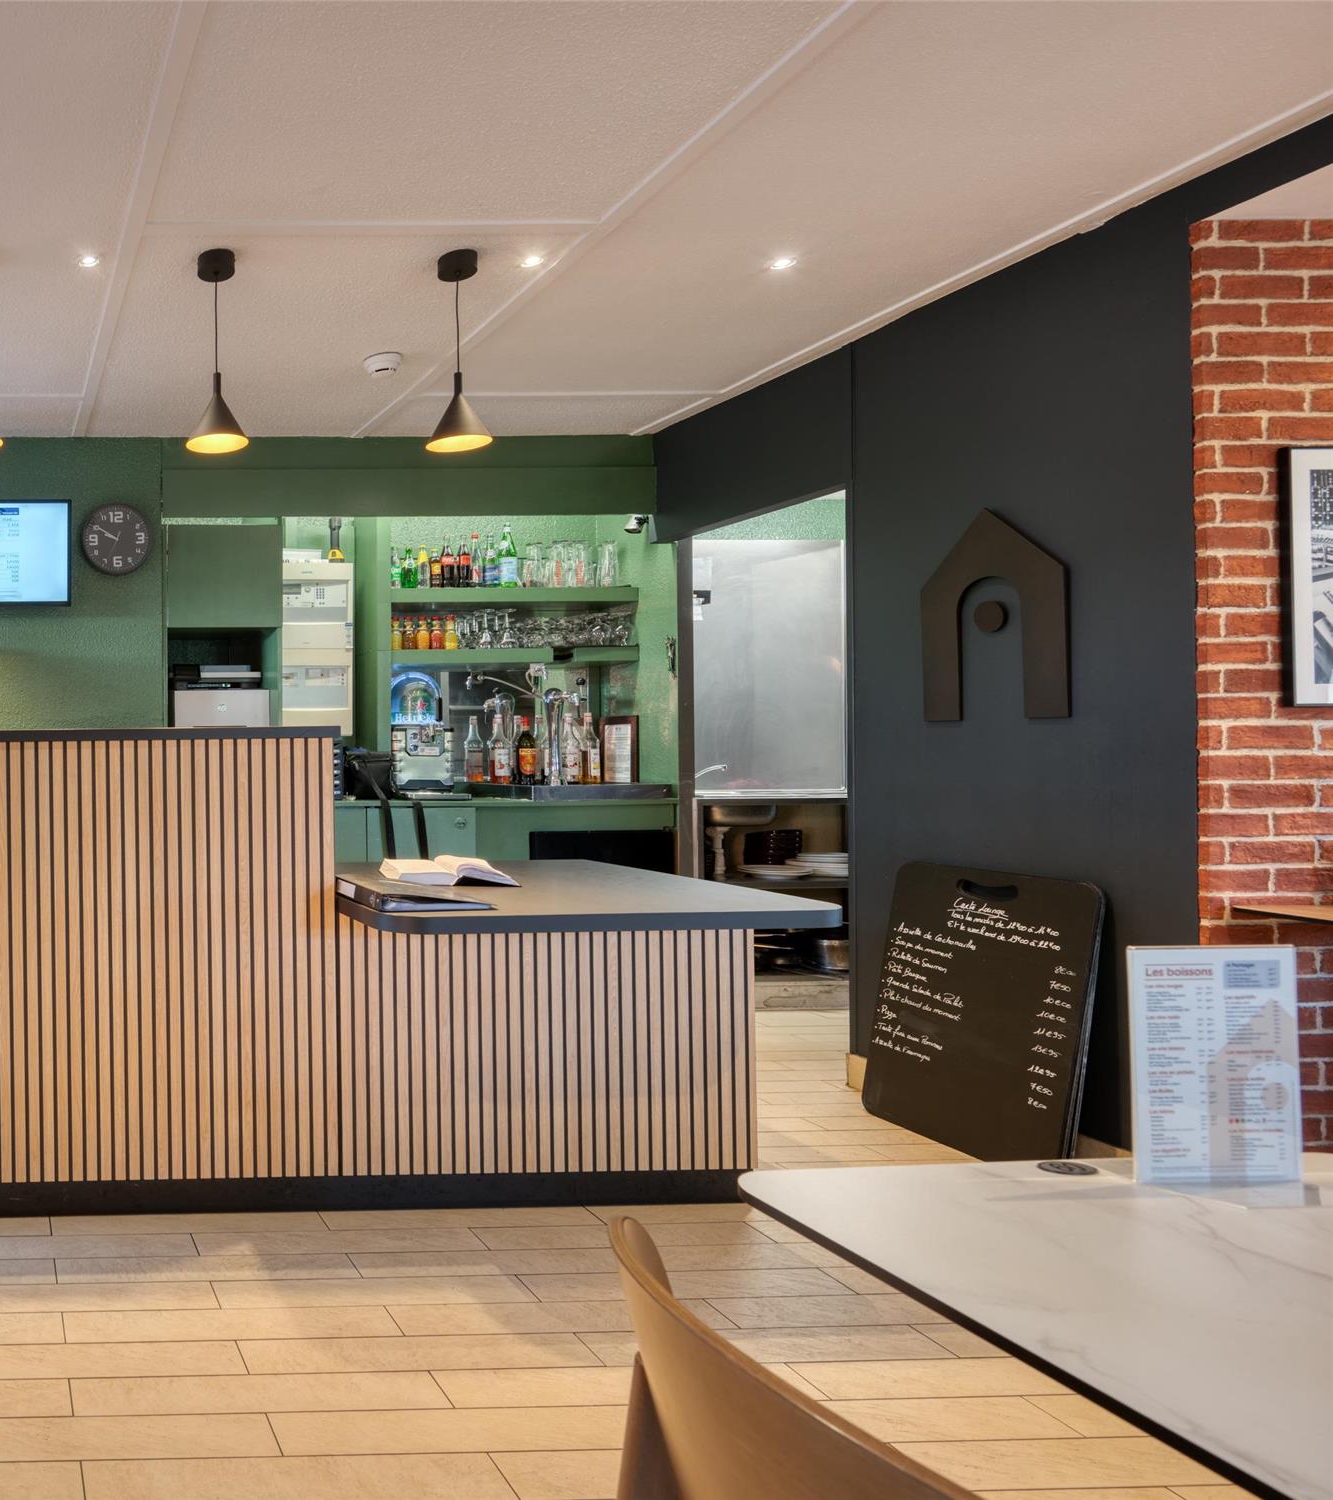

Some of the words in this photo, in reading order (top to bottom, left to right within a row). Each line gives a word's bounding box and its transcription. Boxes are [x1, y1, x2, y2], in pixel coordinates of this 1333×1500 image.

[109, 511, 123, 523] 12
[89, 534, 98, 546] 9
[135, 532, 145, 544] 3
[113, 556, 122, 567] 6
[395, 713, 436, 722] Heineke
[954, 897, 976, 910] Carte
[978, 903, 1008, 918] Lounge
[951, 910, 964, 919] Tous
[995, 921, 1005, 929] de
[923, 931, 932, 940] de
[947, 920, 959, 928] Et
[997, 933, 1006, 941] de
[895, 936, 913, 948] Soupe
[914, 944, 924, 952] du
[924, 948, 953, 959] moment
[912, 957, 920, 965] de
[1145, 967, 1164, 977] Les
[1166, 967, 1213, 977] boissons
[1049, 980, 1072, 992] 7€50
[933, 993, 942, 1001] de
[883, 988, 901, 1001] Plat
[901, 996, 922, 1009] chaud
[922, 1004, 932, 1012] du
[933, 1008, 962, 1021] moment
[881, 1004, 897, 1020] Pizza
[1033, 1028, 1067, 1040] 11€95
[894, 1044, 902, 1052] de
[1031, 1044, 1063, 1058] 13€95
[1030, 1082, 1053, 1096] 7€50
